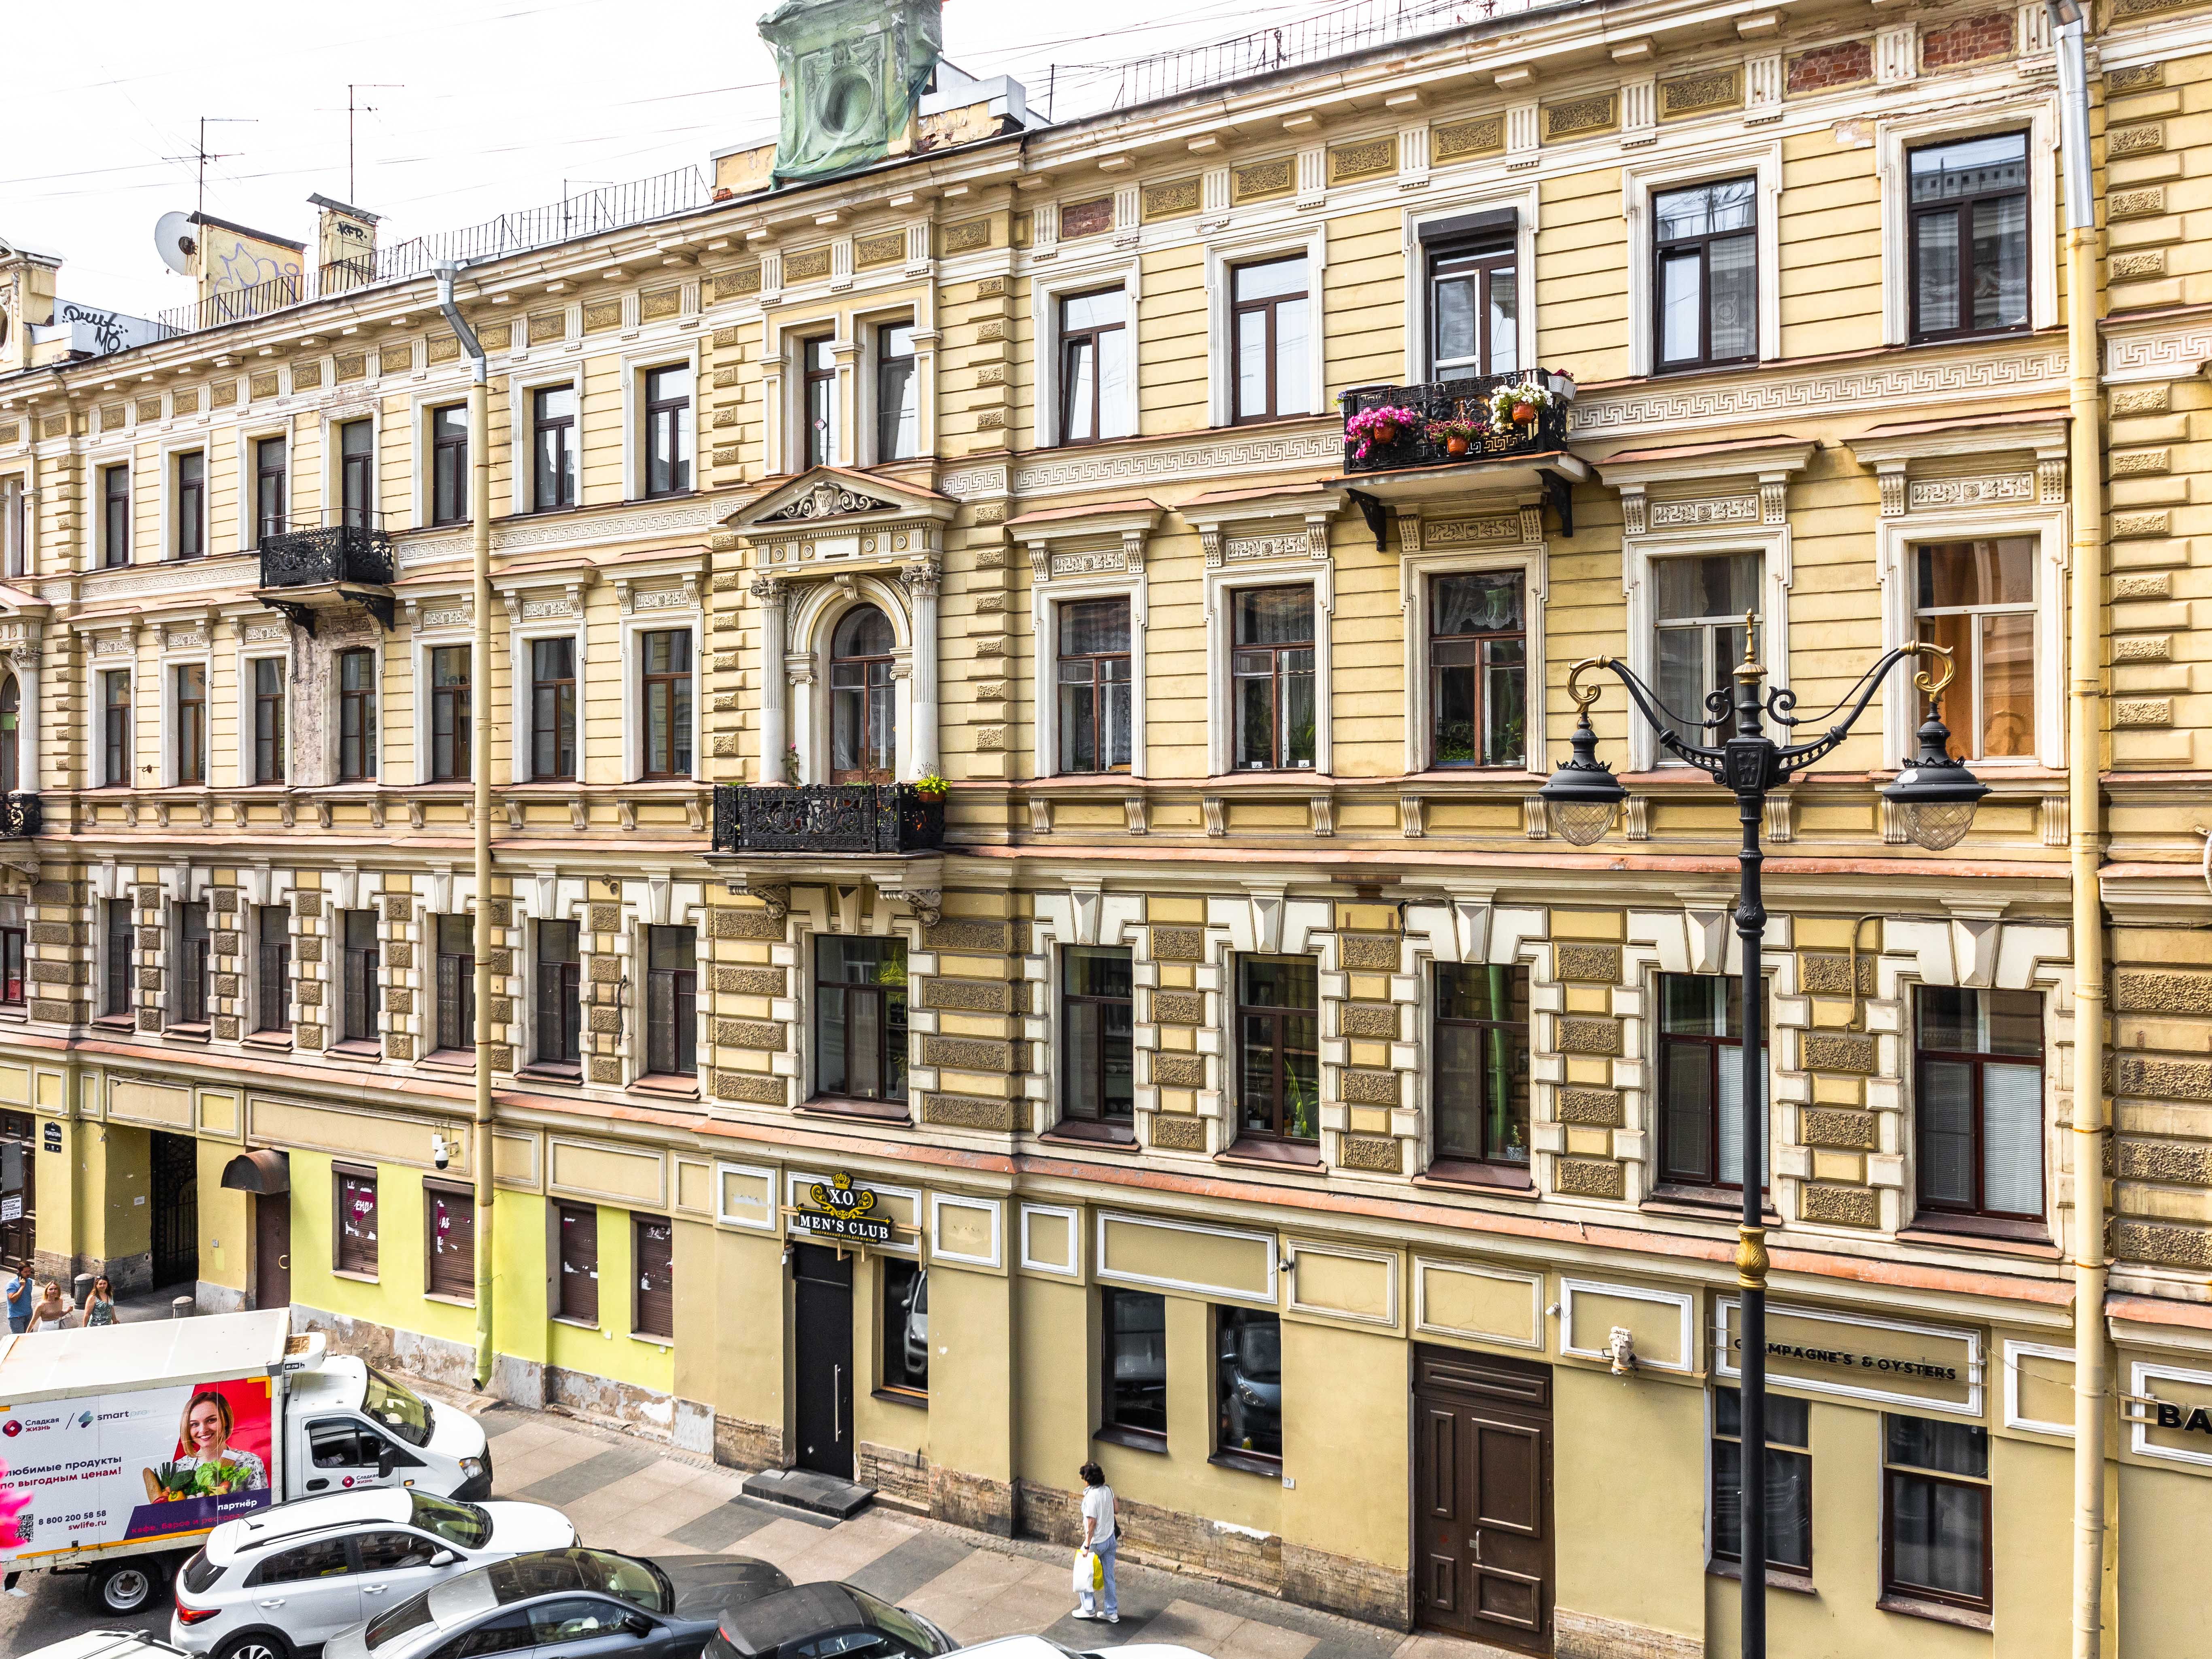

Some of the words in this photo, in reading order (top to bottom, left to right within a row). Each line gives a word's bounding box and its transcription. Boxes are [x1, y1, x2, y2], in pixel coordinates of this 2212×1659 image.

[830, 1189, 855, 1206] X.O.
[800, 1215, 844, 1232] MEN'S
[849, 1222, 888, 1239] CLUB
[1862, 1355, 1873, 1368] &
[1877, 1357, 1957, 1380] OYSTERS
[25, 1417, 59, 1426] Сладкая
[5, 1464, 62, 1476] любимые
[65, 1456, 122, 1470] продукты
[18, 1474, 77, 1488] выгодным
[81, 1466, 121, 1480] ценам!
[217, 1499, 258, 1511] партнёр
[47, 1516, 62, 1524] 800
[65, 1514, 81, 1522] 200
[68, 1520, 106, 1530] swlife.ru
[162, 1520, 190, 1529] баров
